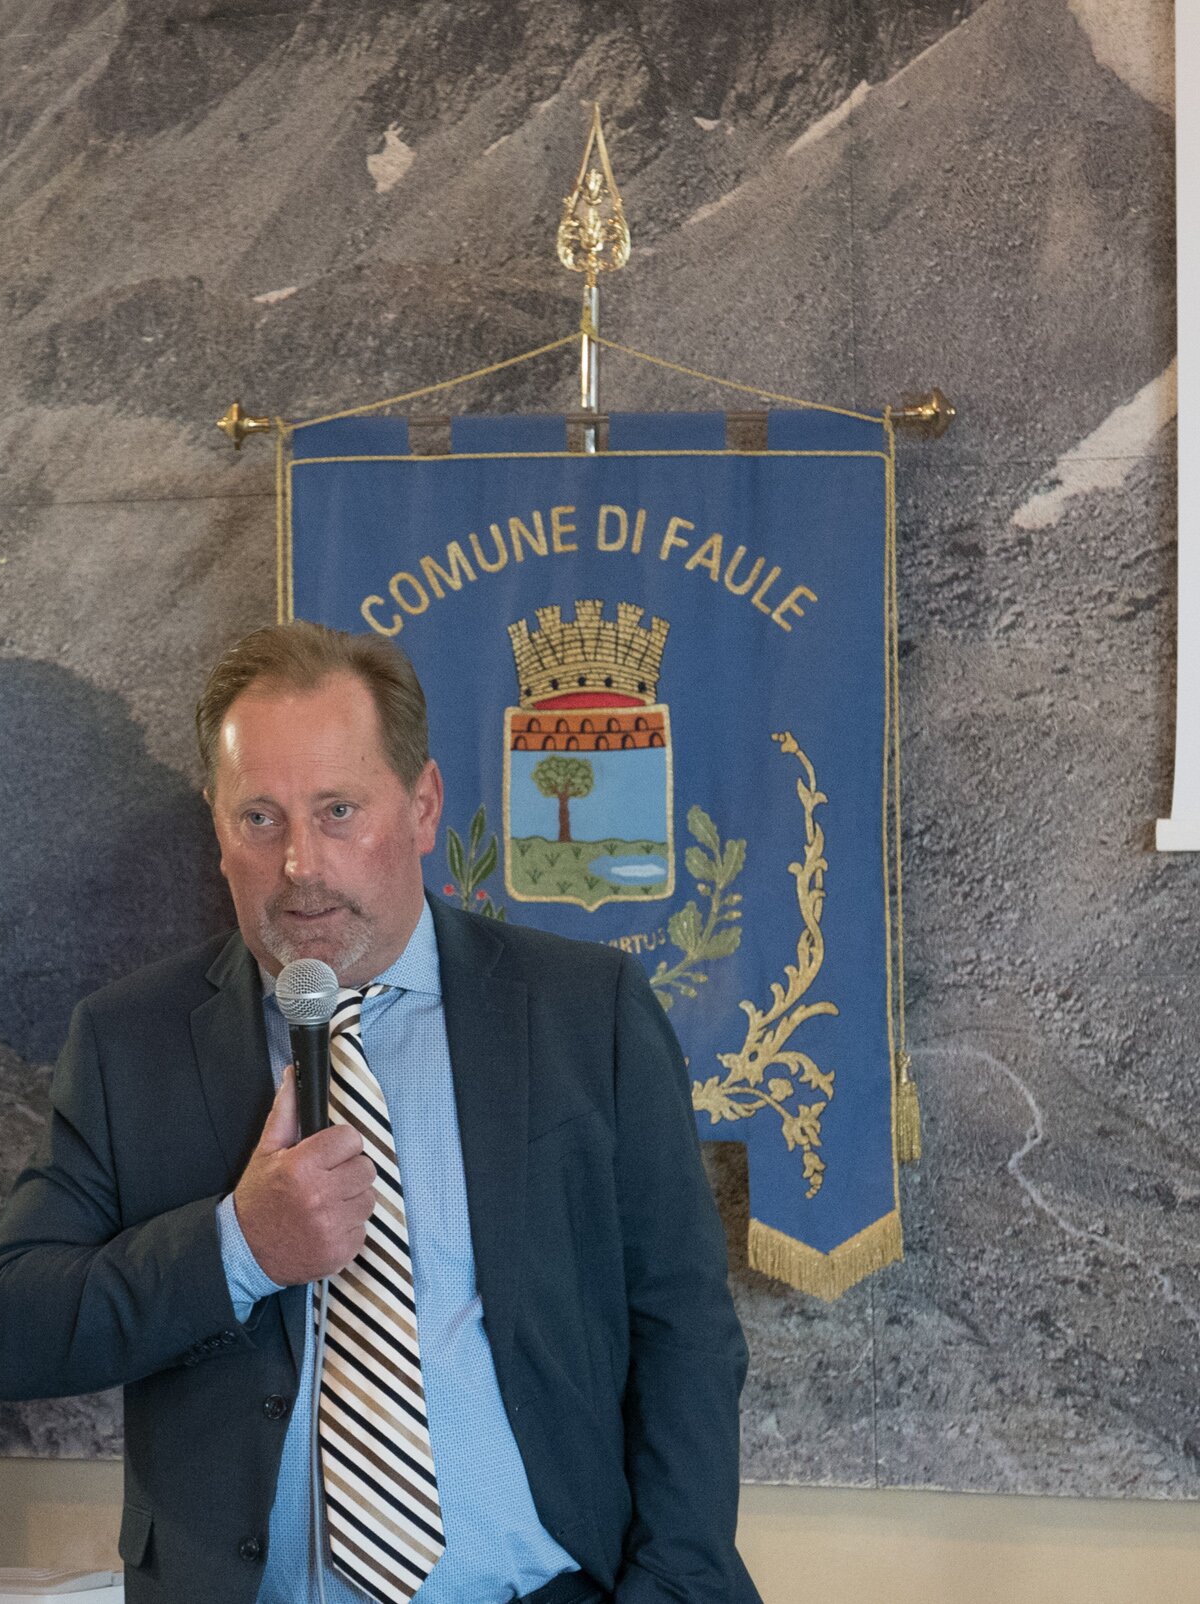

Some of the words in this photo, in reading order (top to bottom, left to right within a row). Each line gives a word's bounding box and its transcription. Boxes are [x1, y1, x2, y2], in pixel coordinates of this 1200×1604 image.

[361, 505, 579, 638] COMUNE
[597, 504, 647, 555] DI
[659, 516, 818, 632] FAULE
